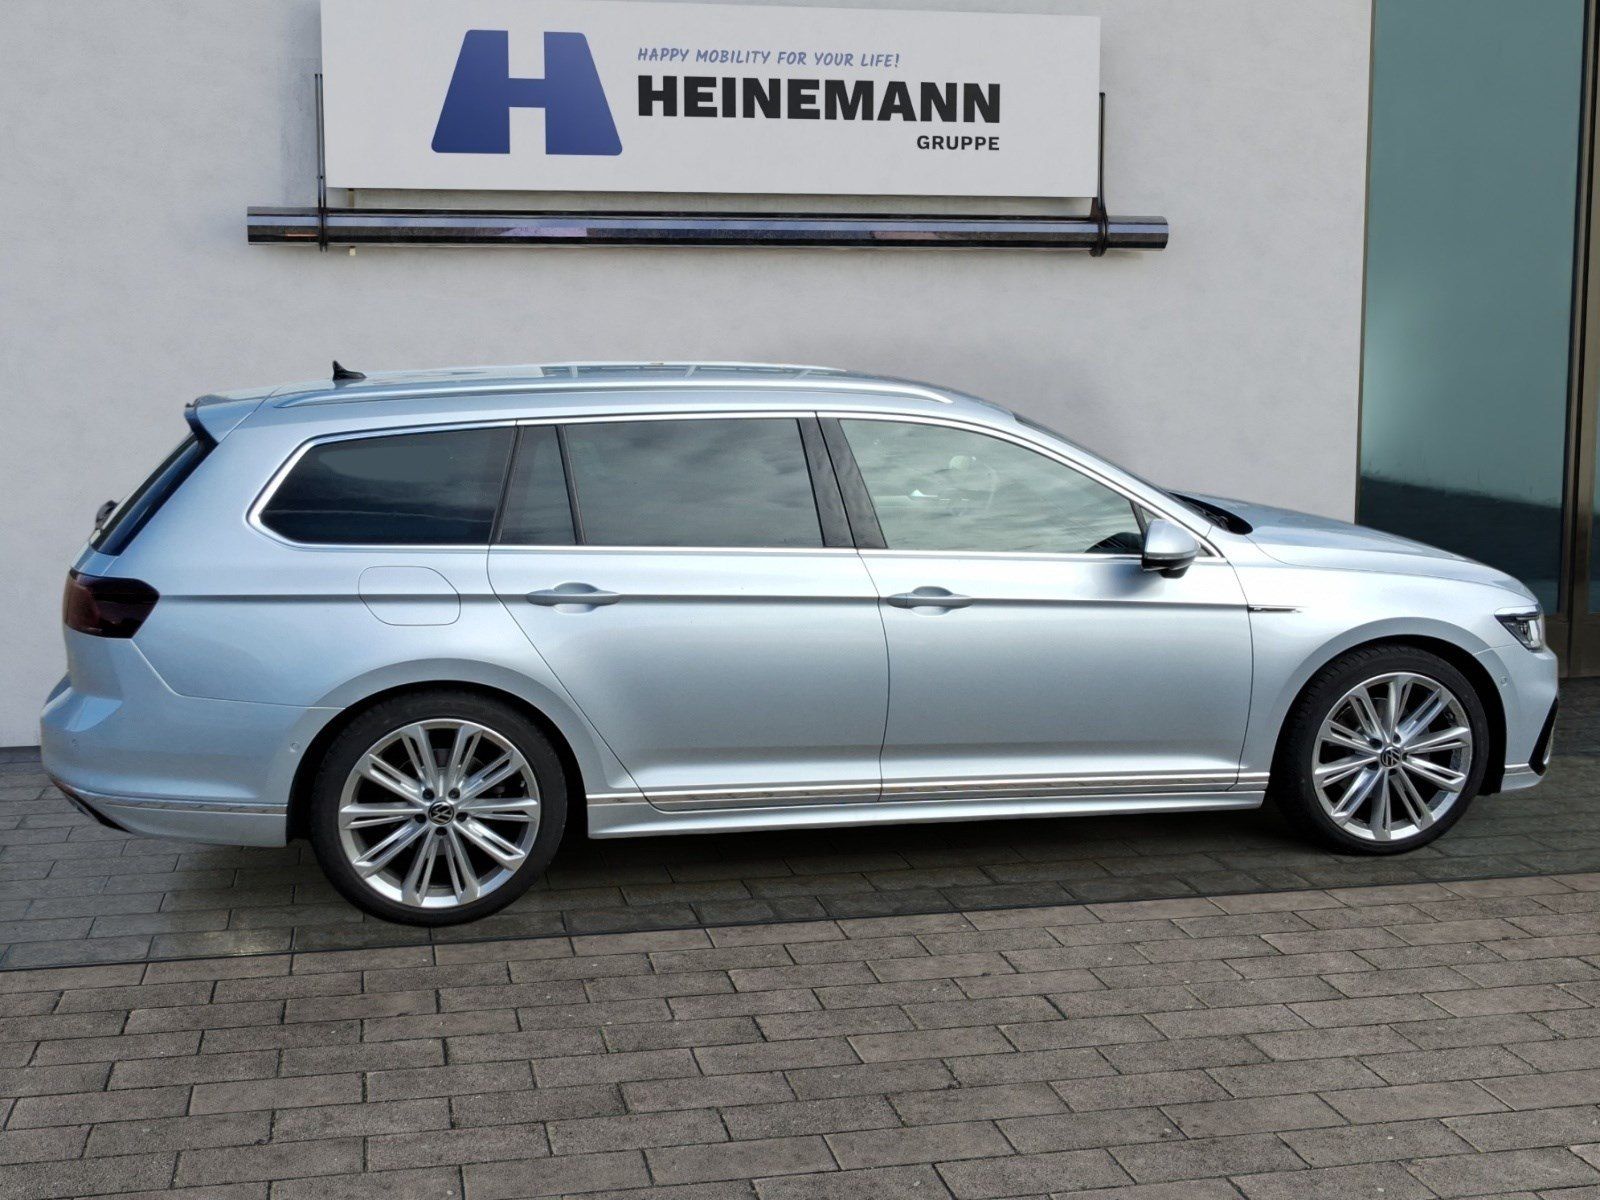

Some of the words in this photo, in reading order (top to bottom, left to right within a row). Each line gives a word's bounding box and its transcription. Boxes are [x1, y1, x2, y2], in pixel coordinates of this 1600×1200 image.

[637, 47, 690, 62] HAPPY
[695, 49, 771, 65] MOBILITY
[777, 51, 807, 66] FOR
[814, 52, 854, 67] YOUR
[860, 53, 900, 68] LIFE!
[431, 29, 623, 157] H
[637, 74, 1001, 124] HEINEMANN
[916, 134, 1000, 151] GRUPPE
